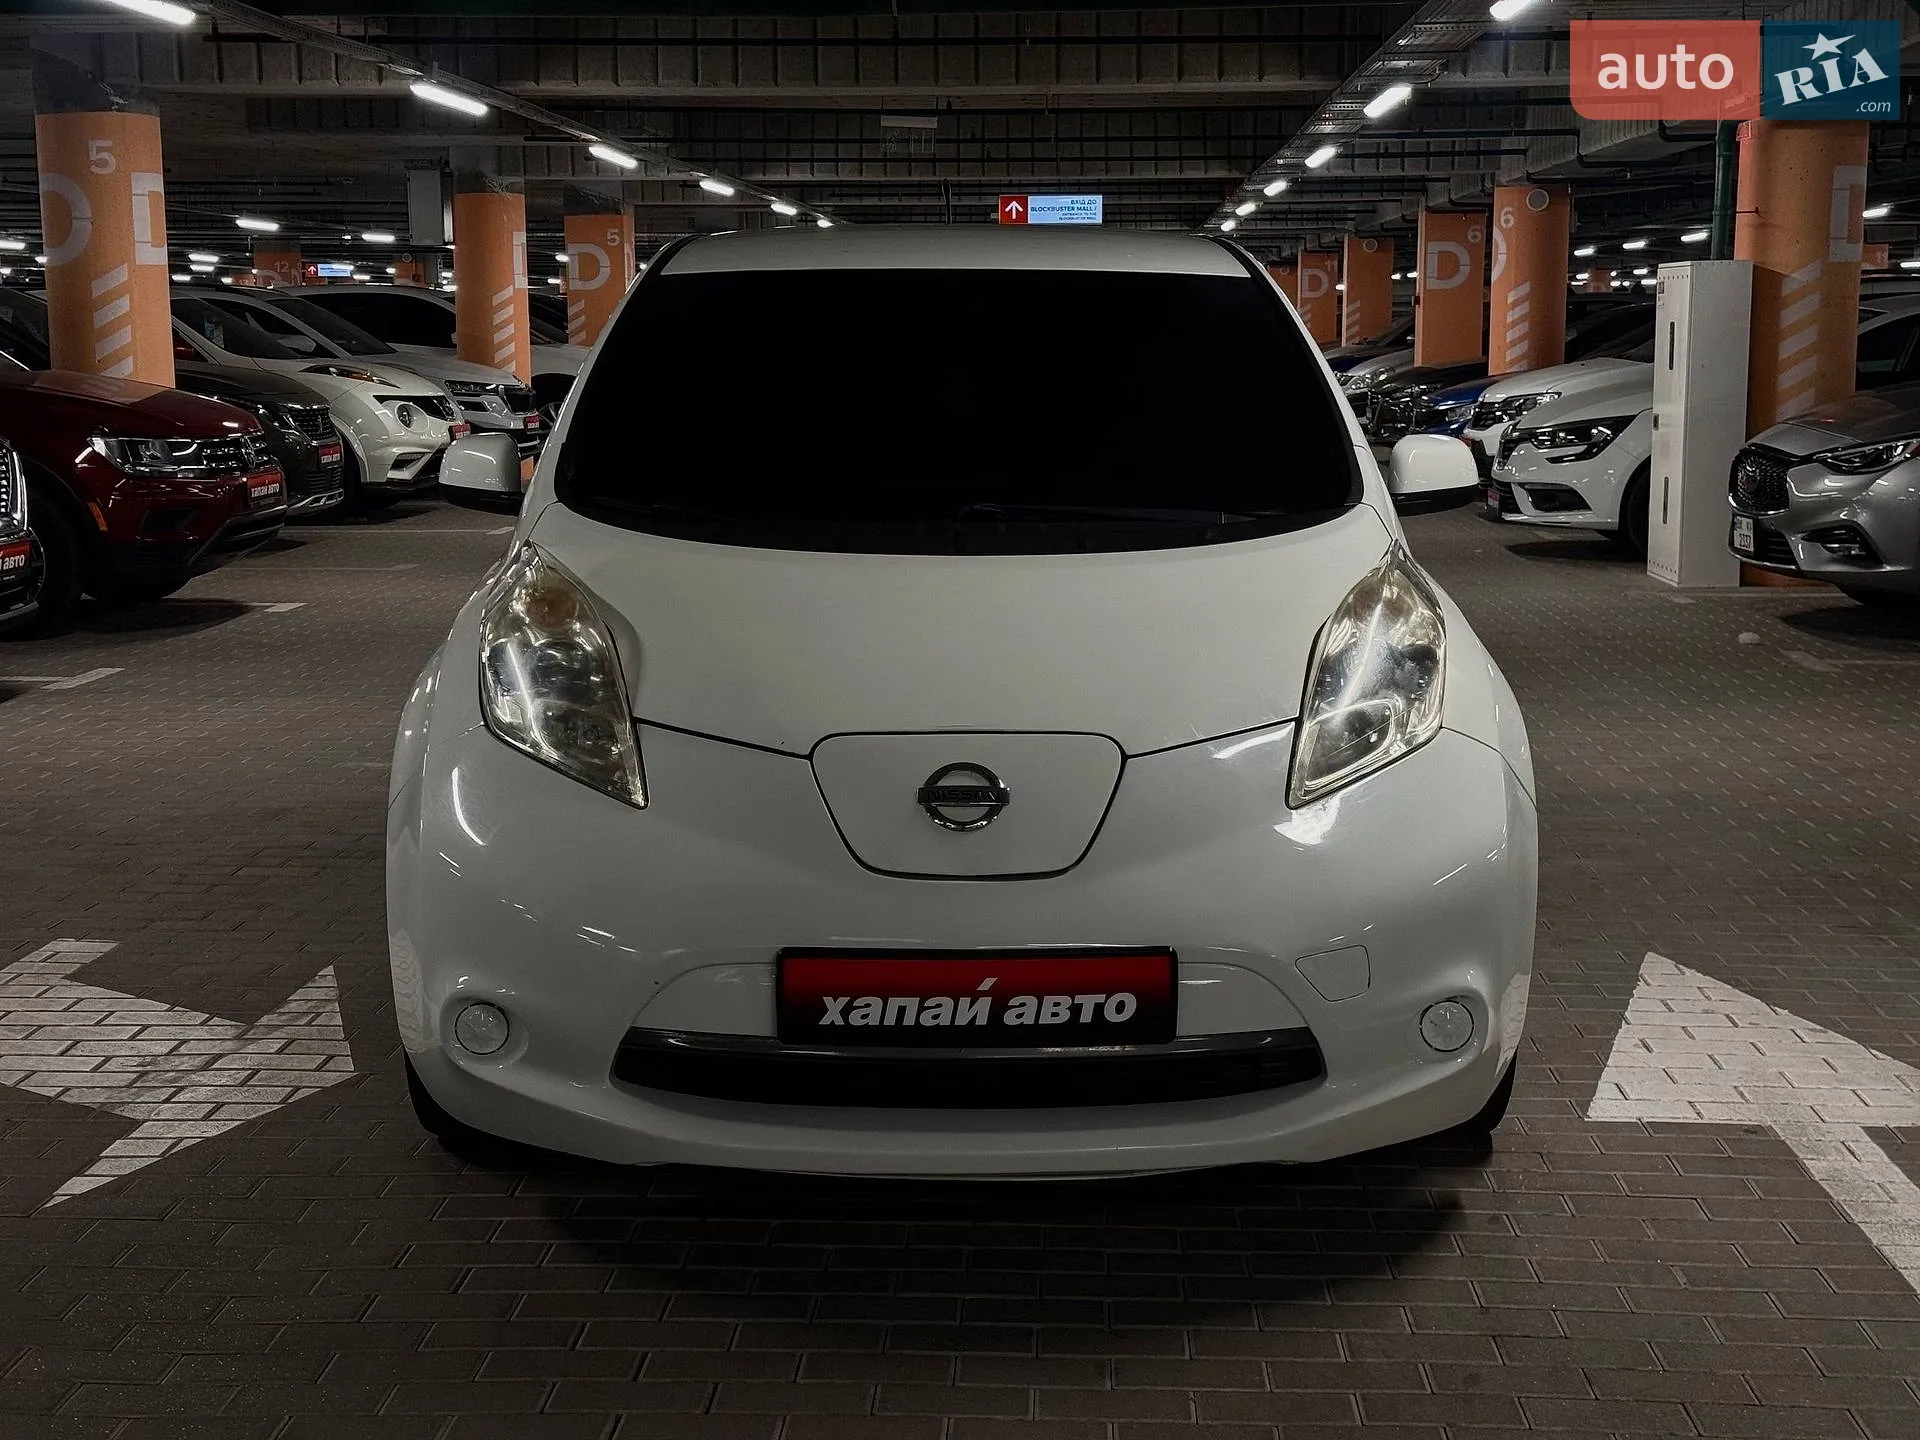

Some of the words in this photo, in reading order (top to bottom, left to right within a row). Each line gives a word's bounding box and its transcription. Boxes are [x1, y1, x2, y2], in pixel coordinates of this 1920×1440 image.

[88, 139, 116, 174] 5
[1500, 206, 1514, 229] 6
[607, 228, 620, 246] 5
[1467, 225, 1482, 245] 6
[274, 261, 289, 273] 12
[567, 242, 611, 291] D
[1426, 240, 1471, 290] D
[1301, 268, 1329, 299] D
[3, 554, 26, 571] авто
[930, 789, 999, 802] NISSAN
[819, 977, 999, 1027] хапай
[1003, 992, 1138, 1026] авто
